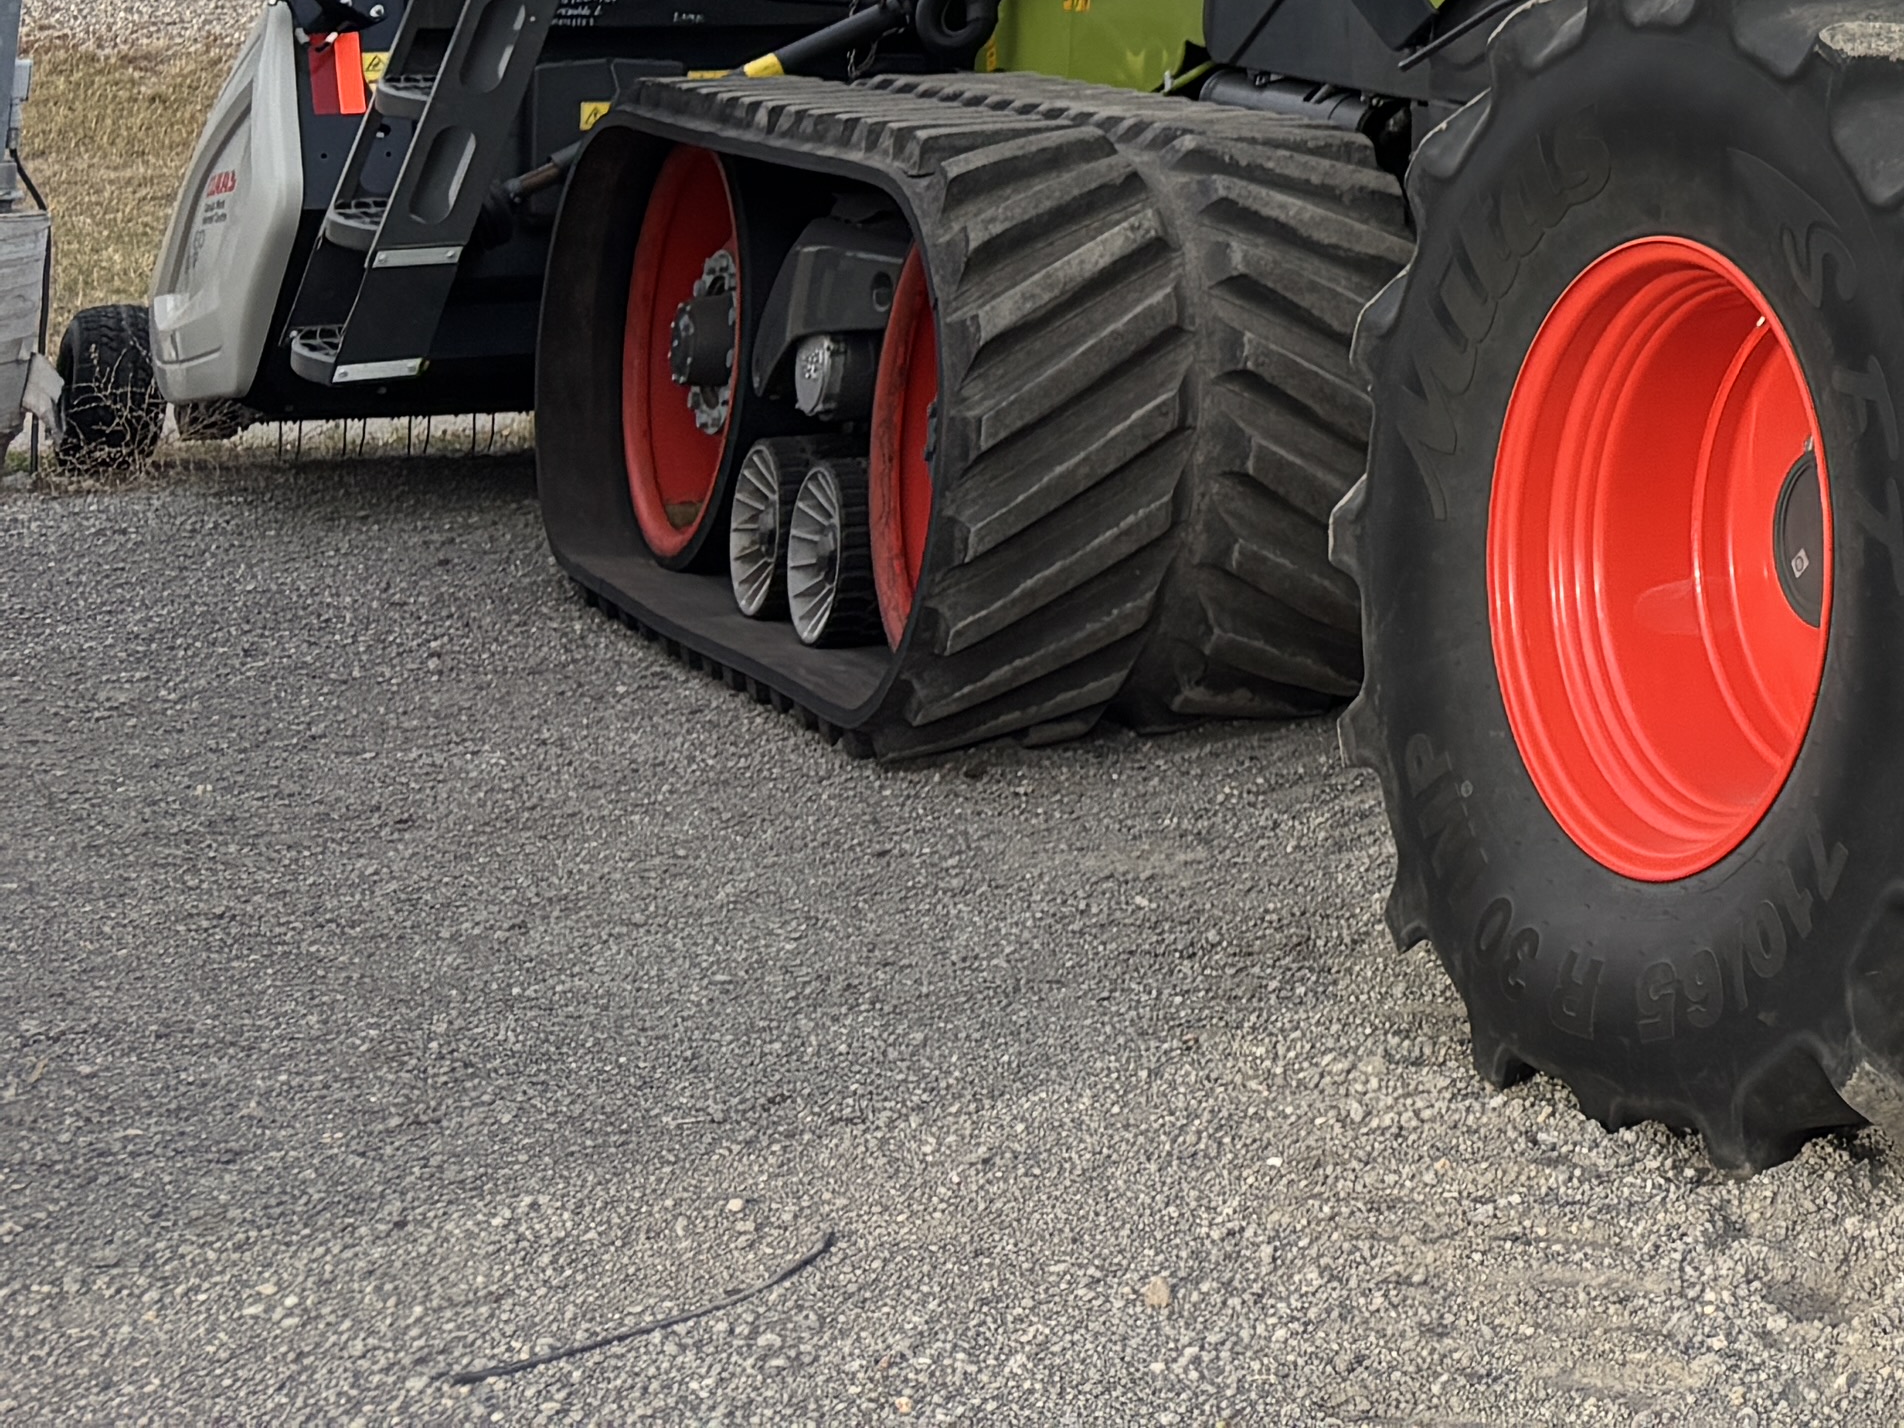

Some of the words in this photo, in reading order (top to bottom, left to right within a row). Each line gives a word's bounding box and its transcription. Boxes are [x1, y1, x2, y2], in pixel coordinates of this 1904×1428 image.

[1397, 100, 1612, 522] Mitas
[1404, 732, 1490, 879] IMP
[1477, 895, 1541, 990] 30
[1550, 954, 1608, 1042] R
[1635, 835, 1851, 1044] 710/65
